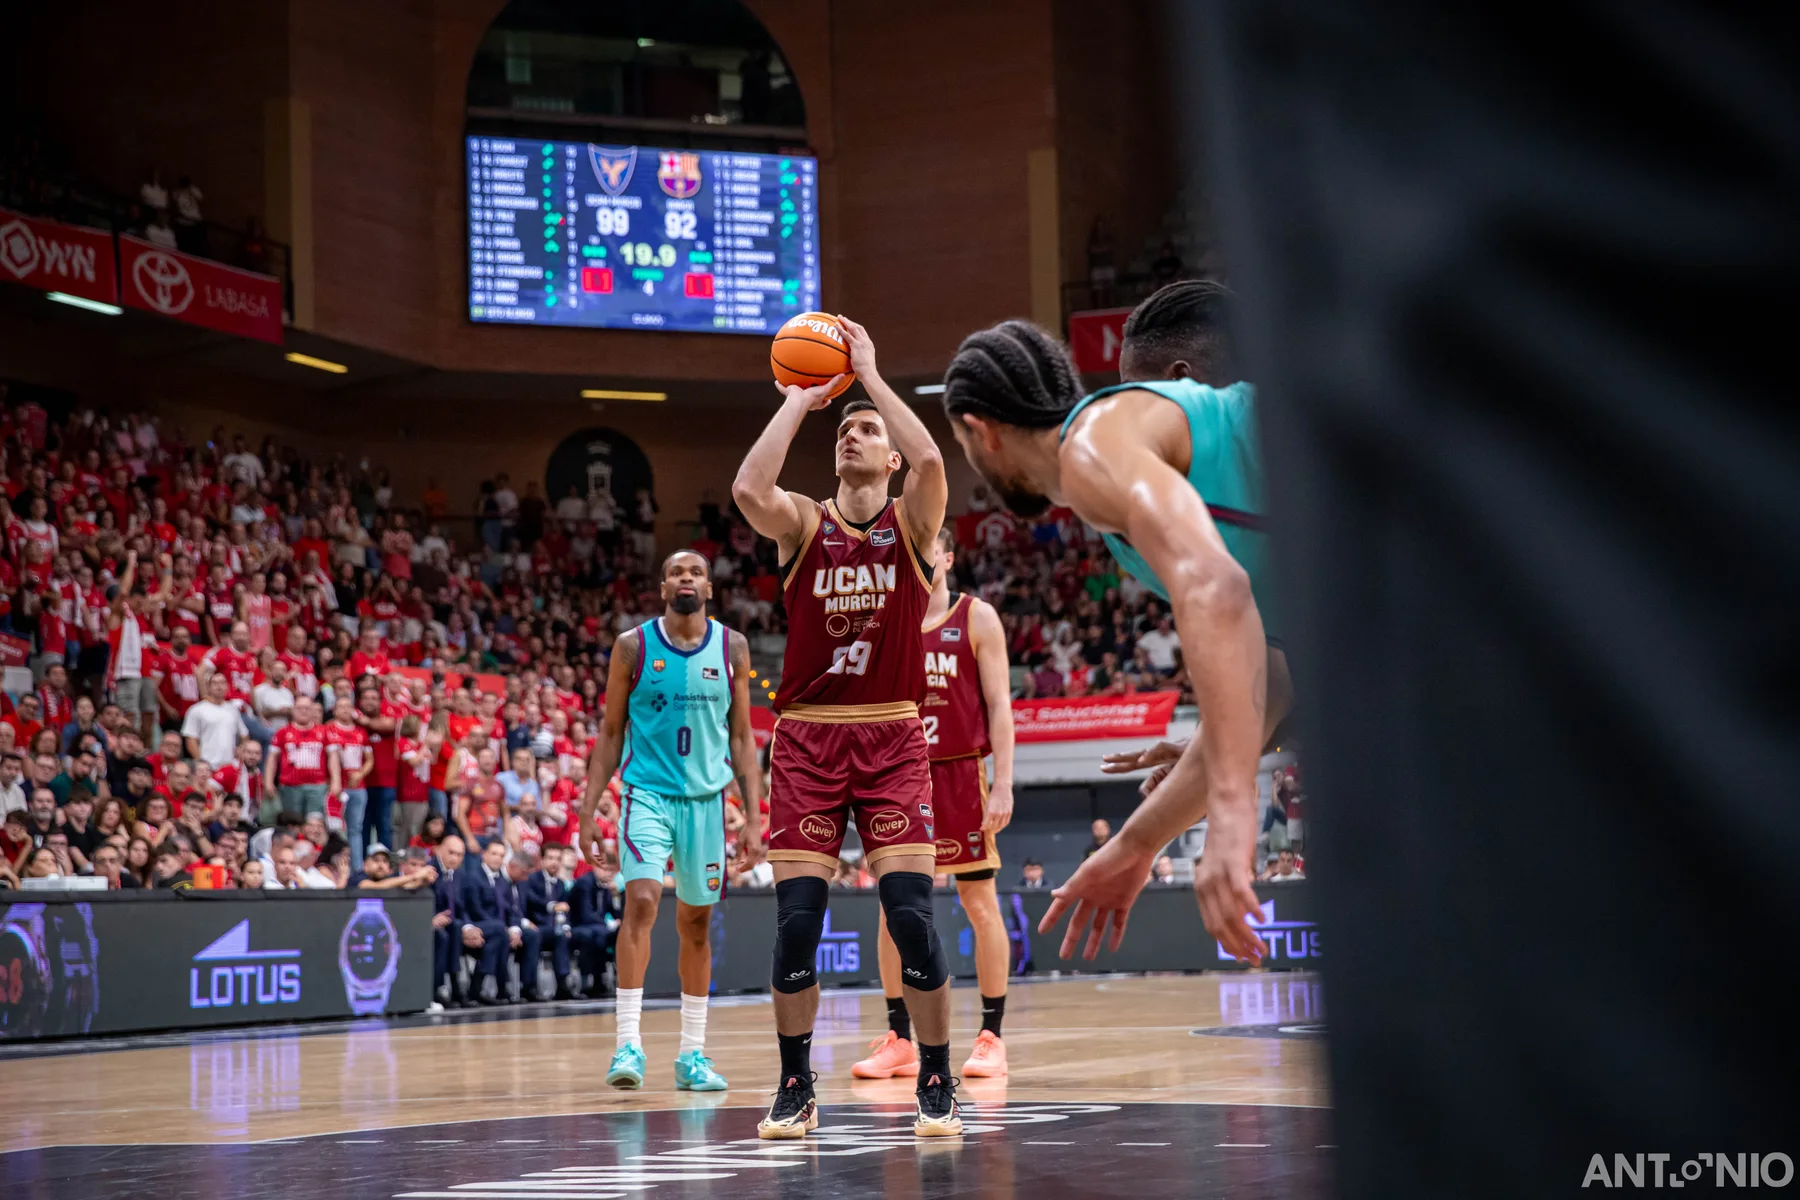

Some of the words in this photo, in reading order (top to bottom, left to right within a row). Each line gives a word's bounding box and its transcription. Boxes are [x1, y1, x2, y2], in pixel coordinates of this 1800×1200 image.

[597, 208, 630, 236] 99
[665, 211, 698, 240] 92
[620, 242, 677, 267] 19.9
[813, 563, 896, 598] UCAM
[825, 594, 886, 614] MURCIA
[925, 652, 957, 677] AM
[927, 674, 948, 688] CIA
[677, 726, 692, 757] 0
[804, 822, 833, 838] Juver
[874, 818, 904, 834] Juver
[936, 846, 958, 855] uver
[816, 942, 860, 974] TUS
[190, 964, 300, 1008] LOTUS
